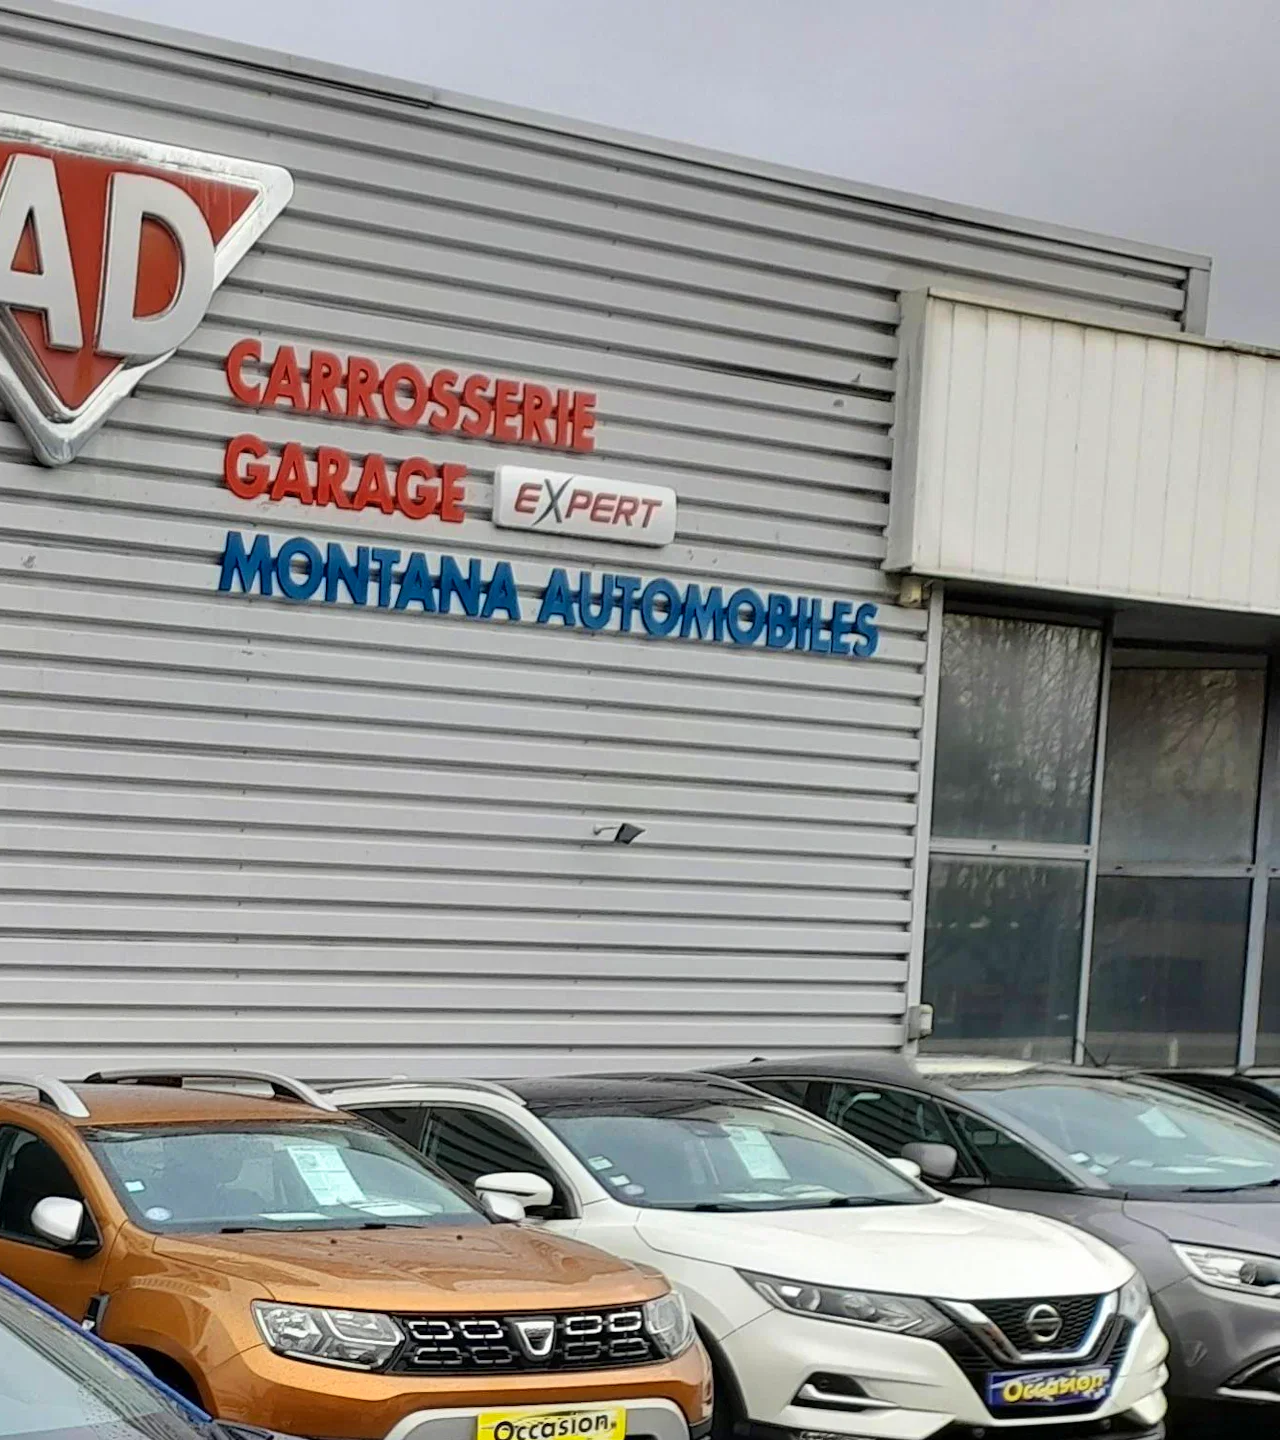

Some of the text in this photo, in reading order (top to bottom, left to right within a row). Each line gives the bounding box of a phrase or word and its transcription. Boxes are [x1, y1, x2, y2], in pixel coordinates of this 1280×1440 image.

[224, 338, 597, 453] CARROSSERIE
[223, 433, 468, 524] GARAGE
[217, 530, 880, 659] MONTANA AUTOMOBILES
[1002, 1369, 1104, 1403] Occasion
